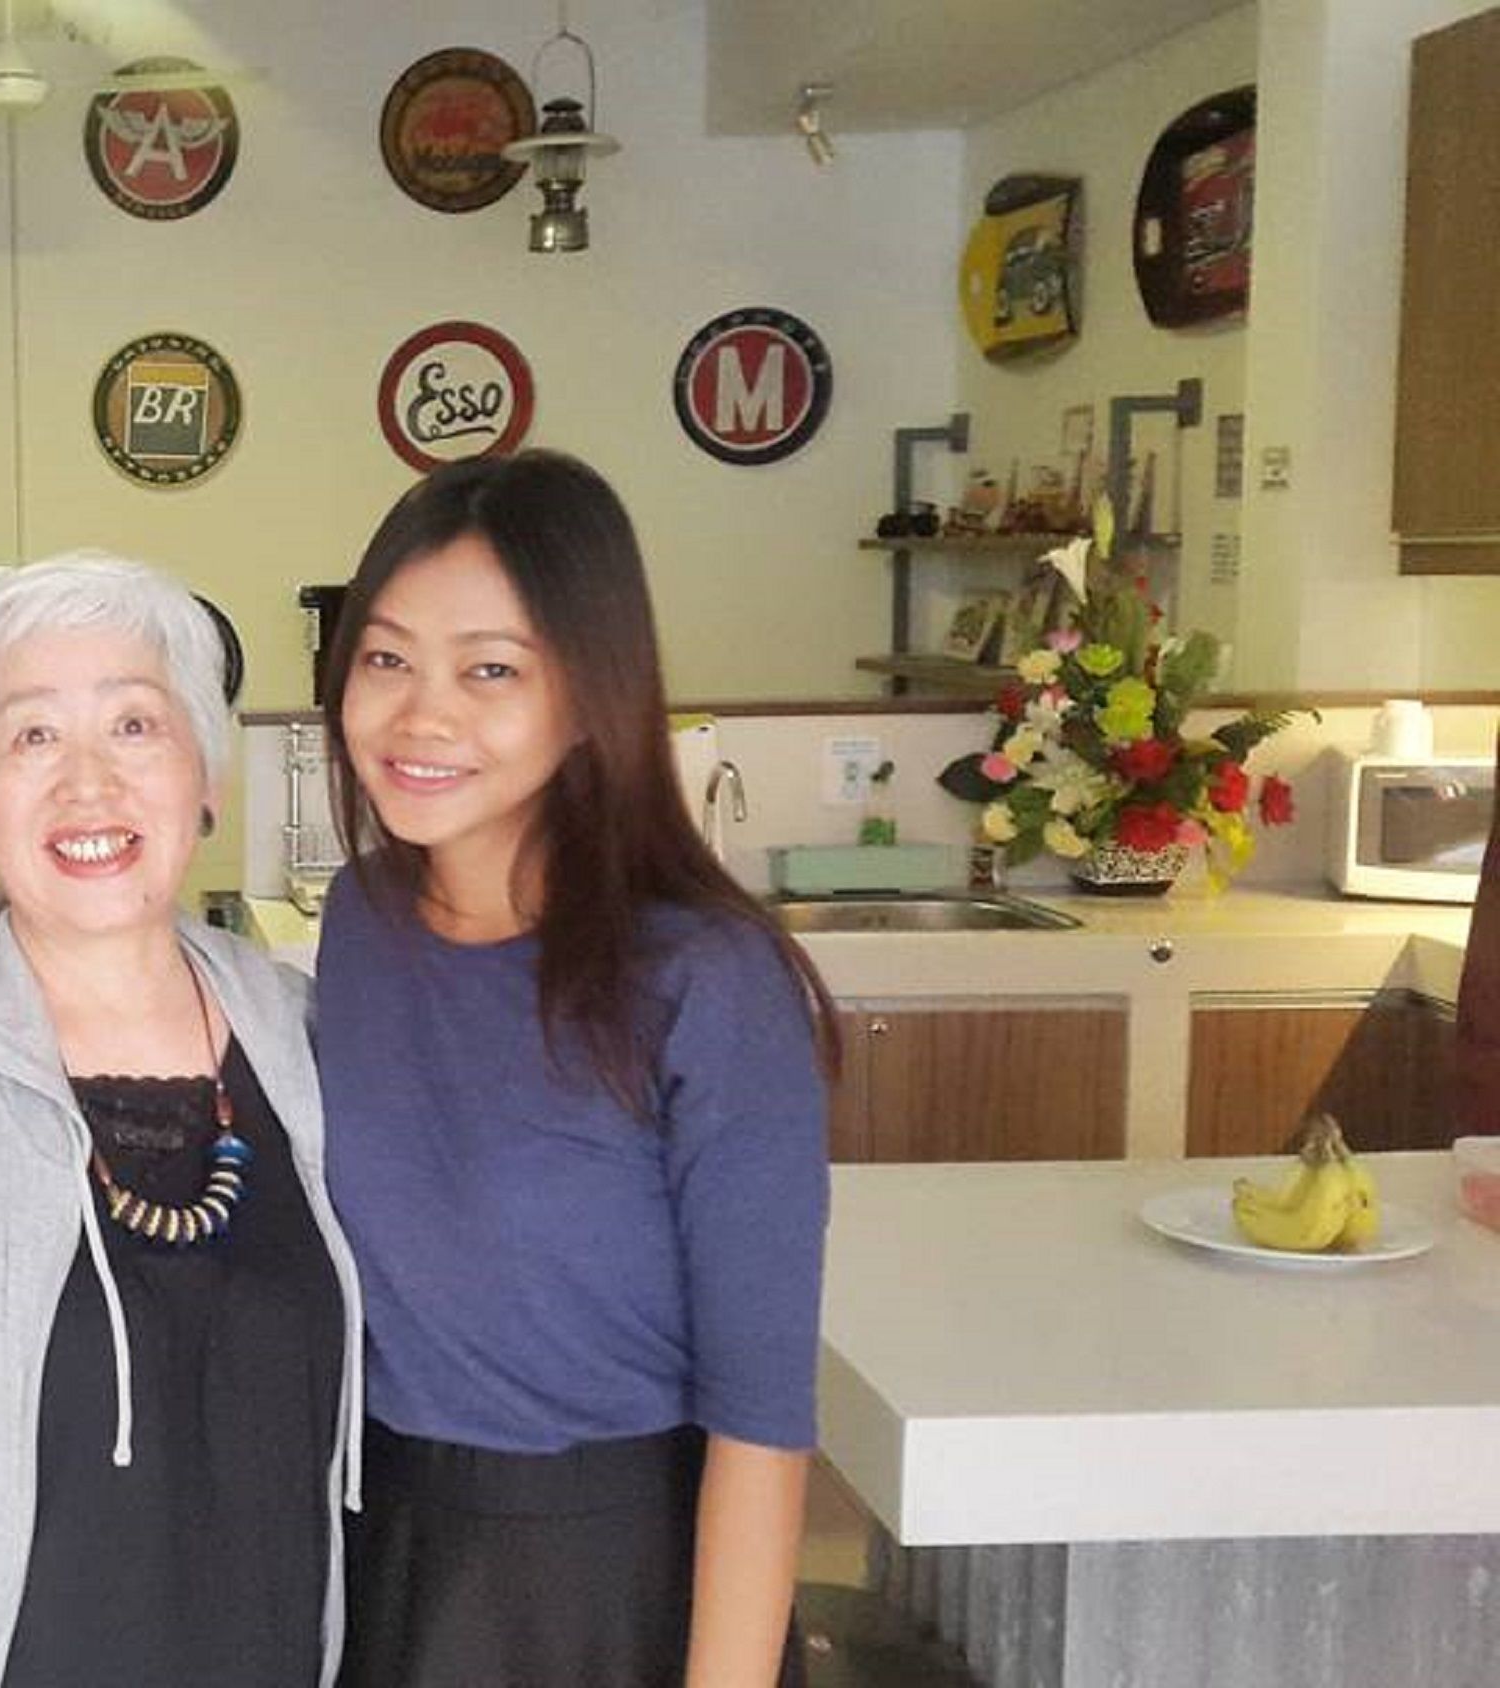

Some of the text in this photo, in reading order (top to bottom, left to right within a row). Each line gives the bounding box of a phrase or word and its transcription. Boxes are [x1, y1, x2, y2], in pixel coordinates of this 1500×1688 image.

[124, 101, 189, 181] A
[133, 386, 198, 424] BR
[406, 362, 503, 442] Esso
[715, 343, 784, 432] M
